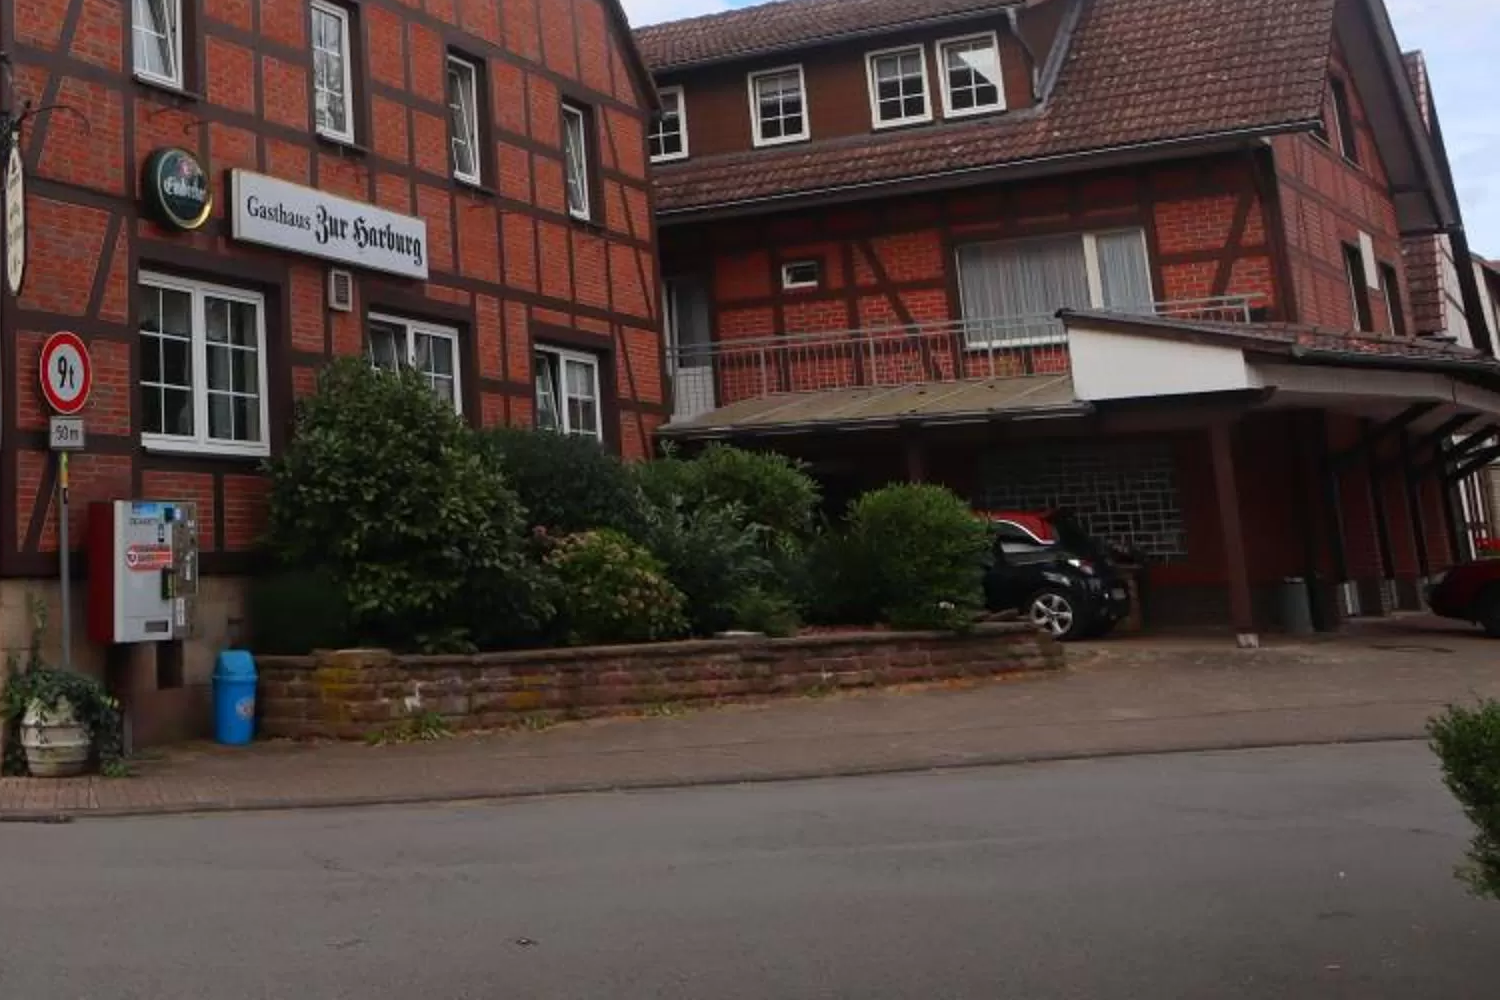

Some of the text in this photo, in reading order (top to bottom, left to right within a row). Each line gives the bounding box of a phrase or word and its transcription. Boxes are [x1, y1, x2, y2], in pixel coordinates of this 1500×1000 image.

[247, 195, 423, 266] Gasthaus Zur Harburg
